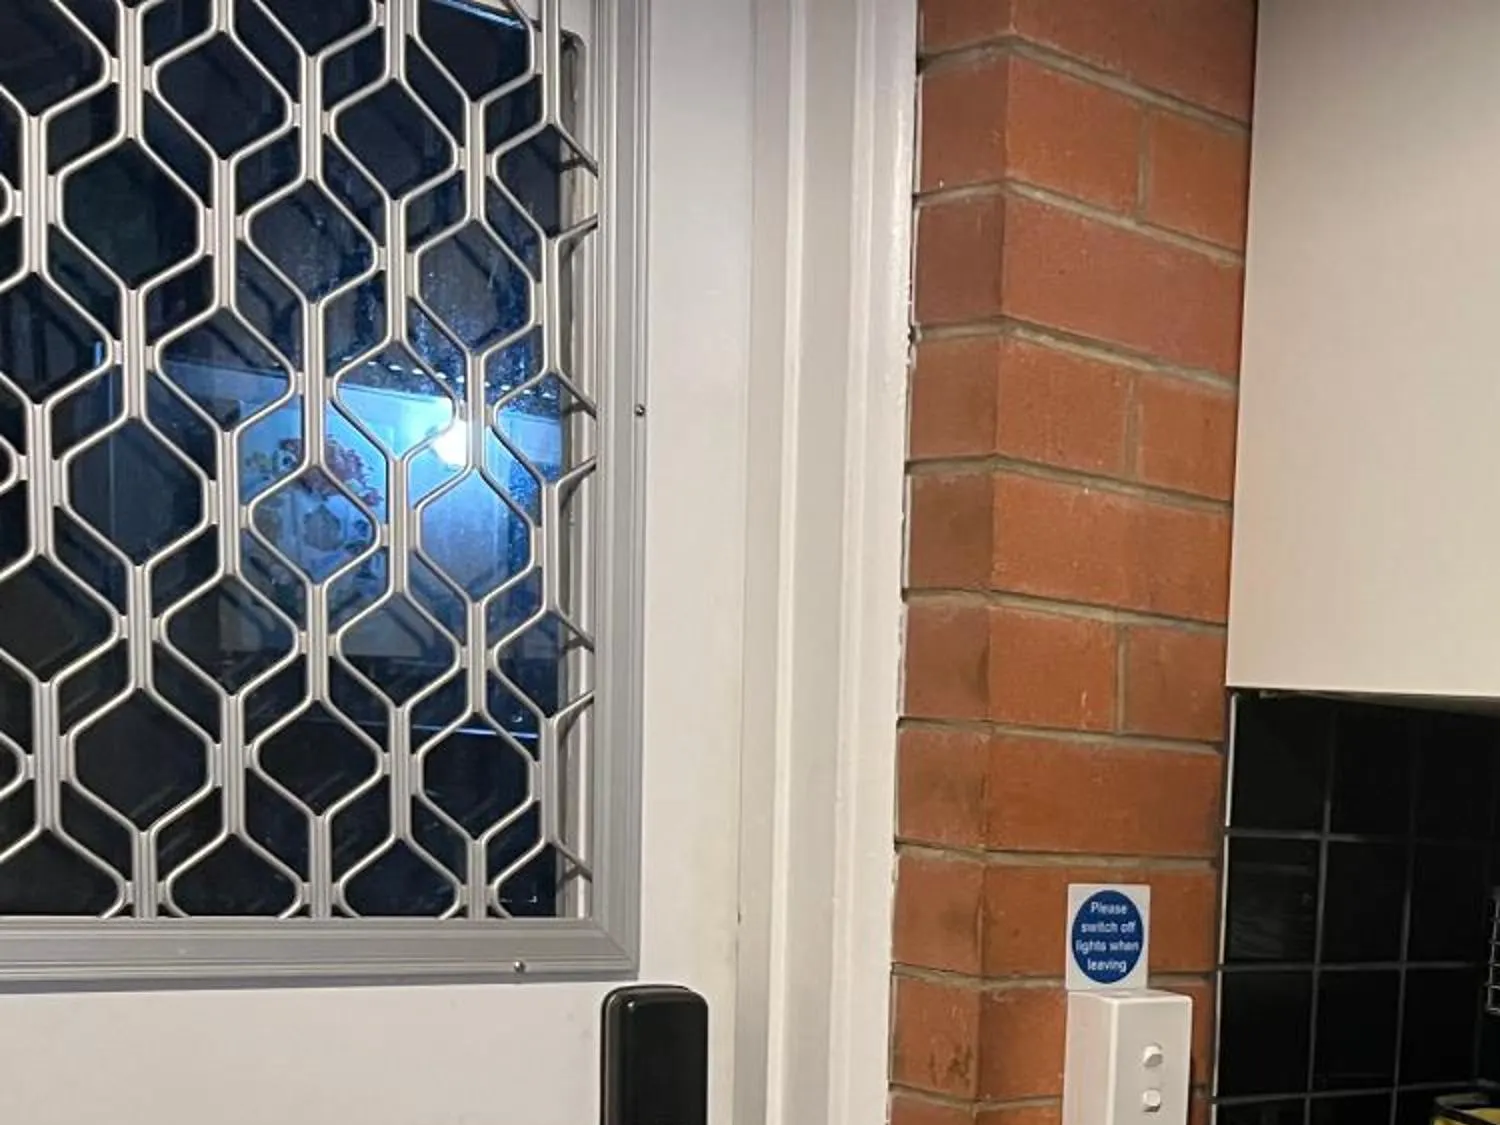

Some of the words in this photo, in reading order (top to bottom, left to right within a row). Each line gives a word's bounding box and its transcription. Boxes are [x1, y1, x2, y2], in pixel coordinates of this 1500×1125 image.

[1091, 901, 1127, 914] Please
[1082, 922, 1118, 933] switch
[1120, 920, 1137, 933] off
[1075, 939, 1107, 955] lights
[1109, 939, 1140, 951] when
[1087, 958, 1127, 973] leaving
